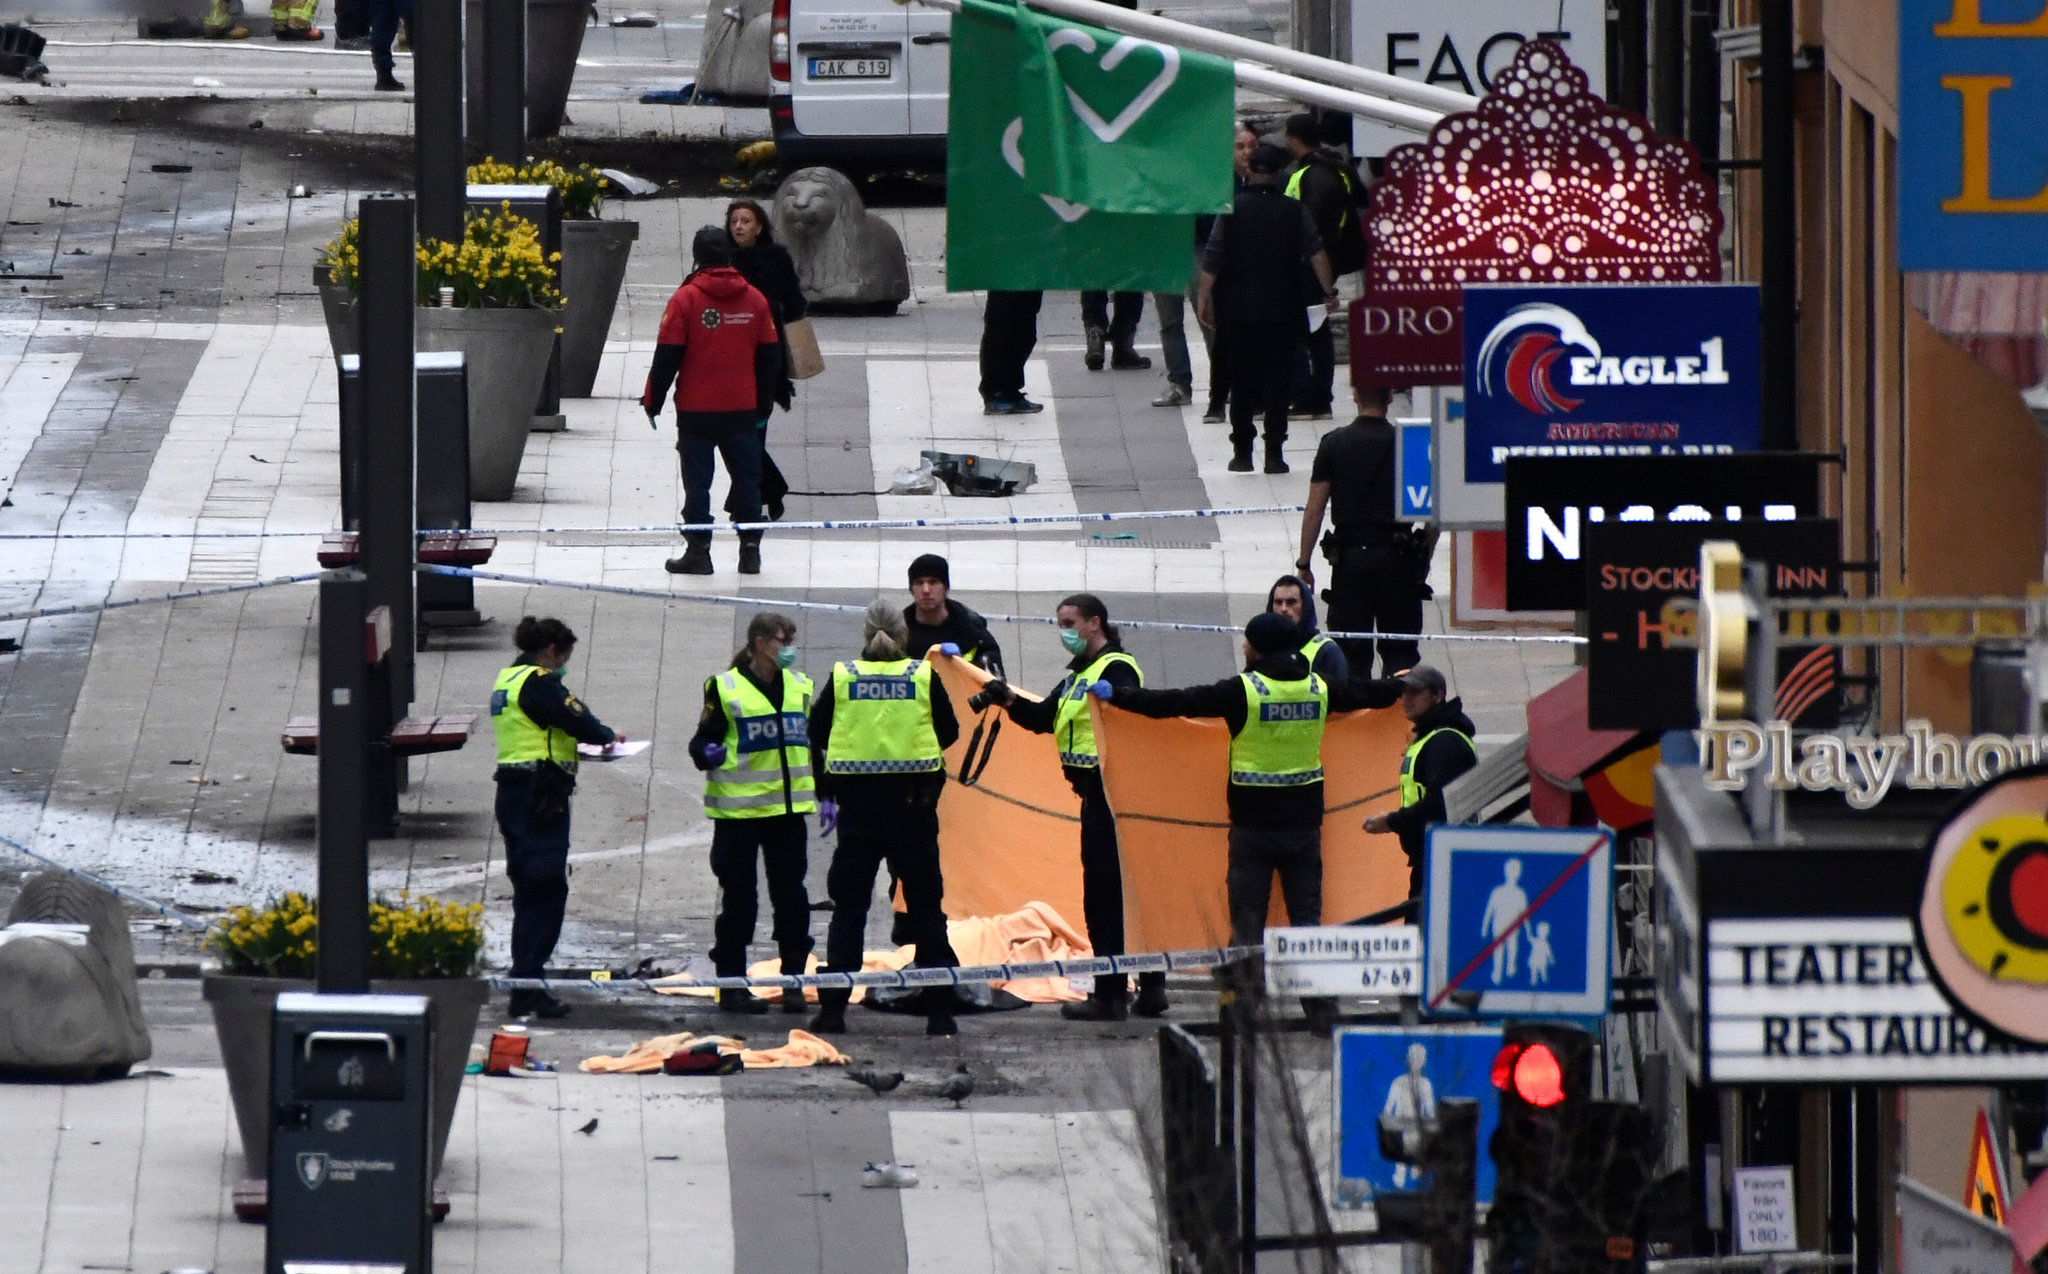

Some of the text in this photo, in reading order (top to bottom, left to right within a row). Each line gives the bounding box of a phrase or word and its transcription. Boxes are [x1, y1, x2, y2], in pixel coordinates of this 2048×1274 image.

[818, 61, 886, 75] CAK 619
[1387, 31, 1571, 97] FAC
[1364, 307, 1464, 336] DRO
[1570, 336, 1730, 386] EAGLE1
[1548, 422, 1679, 441] AMERICAN
[1406, 485, 1432, 508] V
[1777, 565, 1827, 588] INN
[856, 683, 907, 699] POLIS
[1268, 703, 1314, 720] POLIS
[1737, 944, 1914, 985] TEATER
[1361, 967, 1411, 988] 67-69
